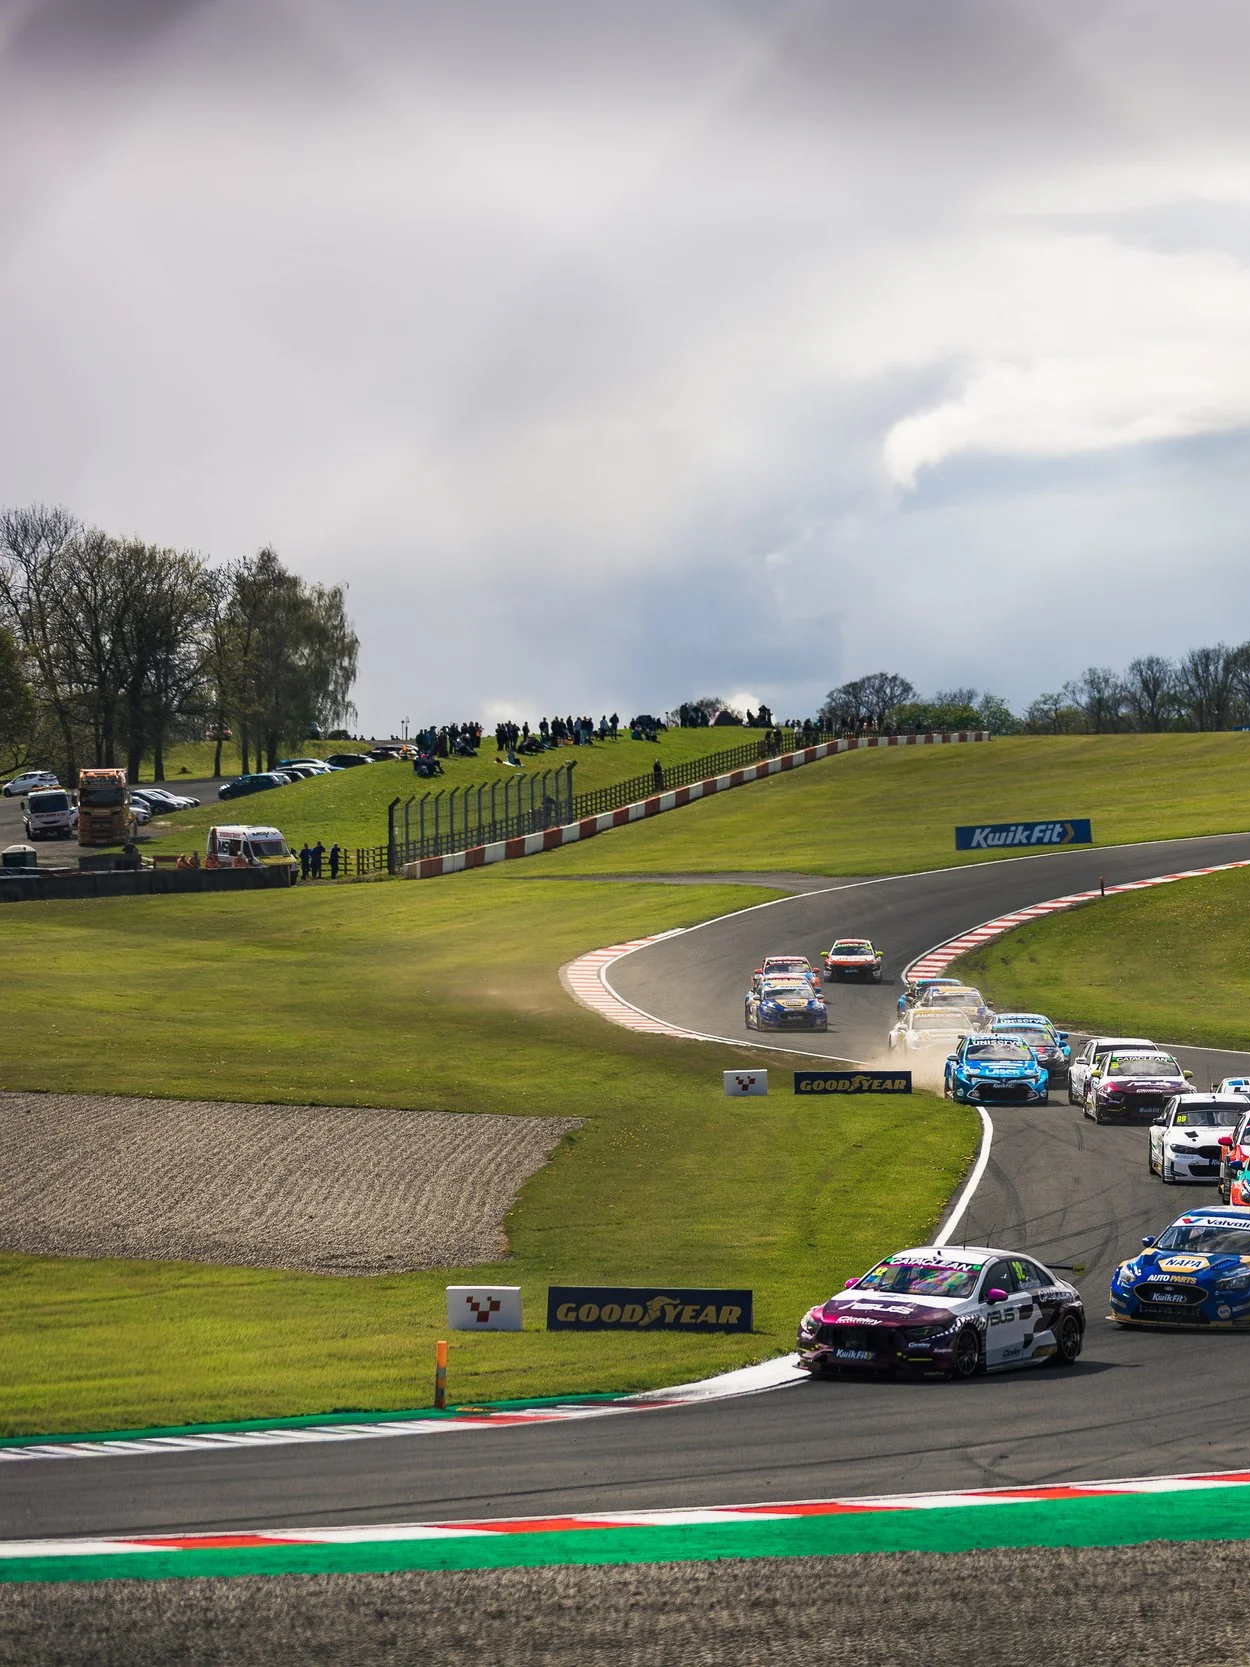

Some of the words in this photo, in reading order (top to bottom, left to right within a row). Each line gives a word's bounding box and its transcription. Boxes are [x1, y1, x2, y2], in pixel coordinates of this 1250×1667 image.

[891, 1257, 972, 1272] CATACLEAN
[1165, 1258, 1202, 1268] NAPA
[1147, 1274, 1170, 1282] AUTO
[1169, 1275, 1197, 1284] PARTS
